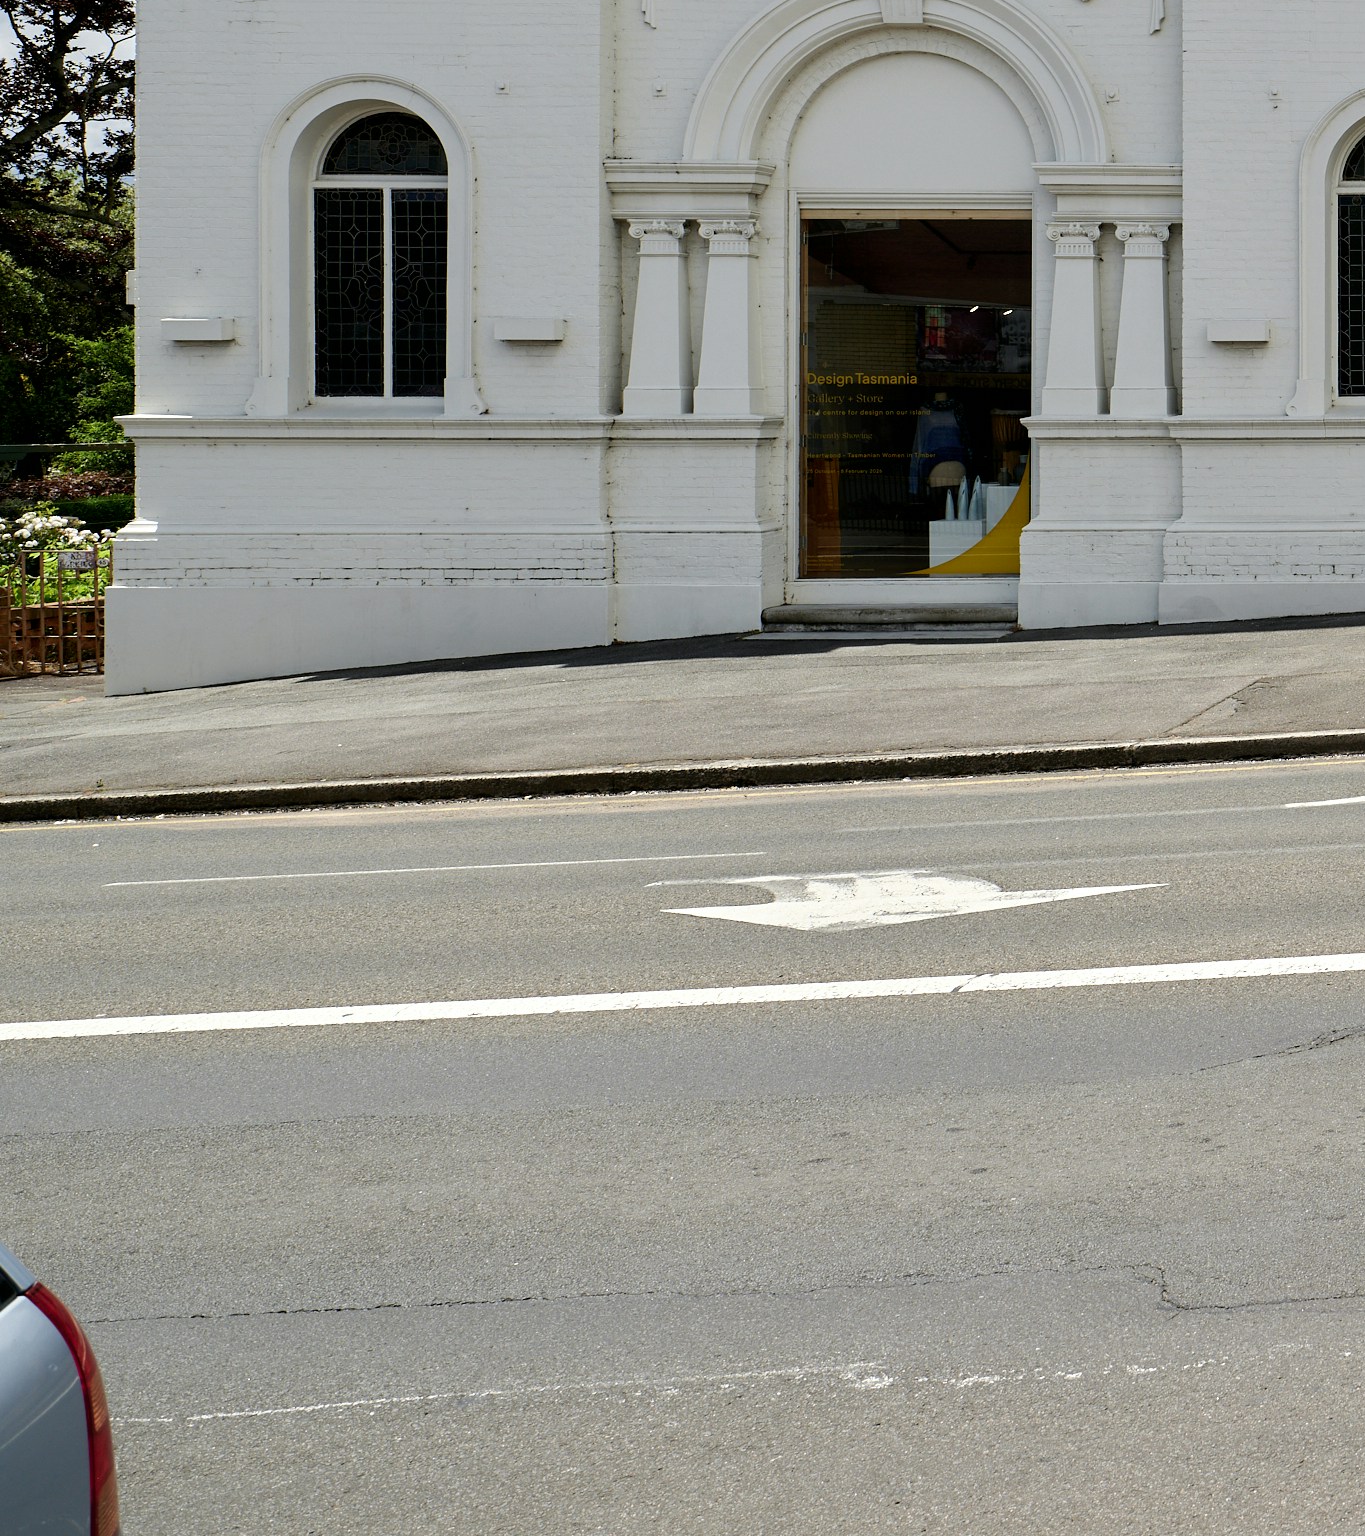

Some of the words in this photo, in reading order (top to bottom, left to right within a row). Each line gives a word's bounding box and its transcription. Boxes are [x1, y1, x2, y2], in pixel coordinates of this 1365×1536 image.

[807, 373, 853, 387] Design
[855, 373, 918, 385] Tasmania
[808, 393, 845, 405] Gallery
[856, 393, 884, 403] Store
[860, 409, 884, 417] design
